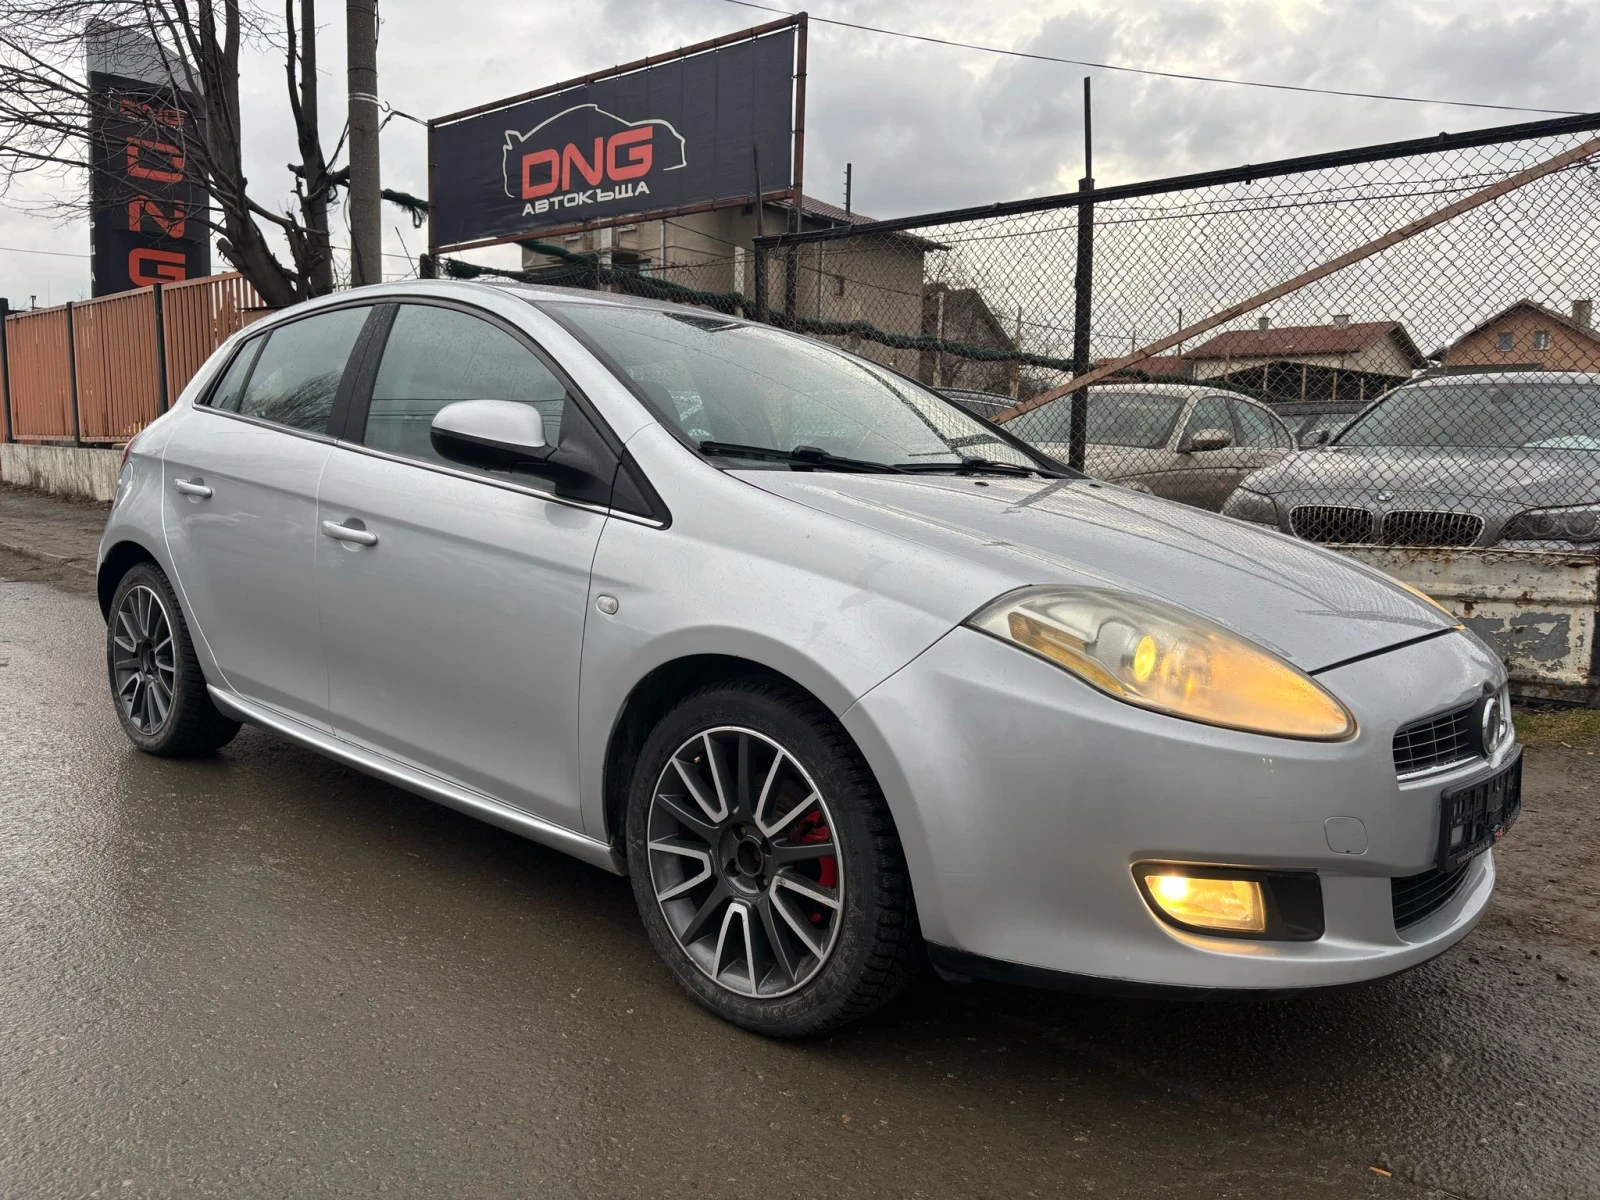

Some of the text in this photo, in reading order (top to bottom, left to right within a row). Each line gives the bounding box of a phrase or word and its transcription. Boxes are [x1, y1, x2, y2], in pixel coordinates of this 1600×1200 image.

[522, 126, 653, 198] DNG
[128, 138, 187, 287] DNG
[522, 181, 651, 216] АВТОКЪЩА
